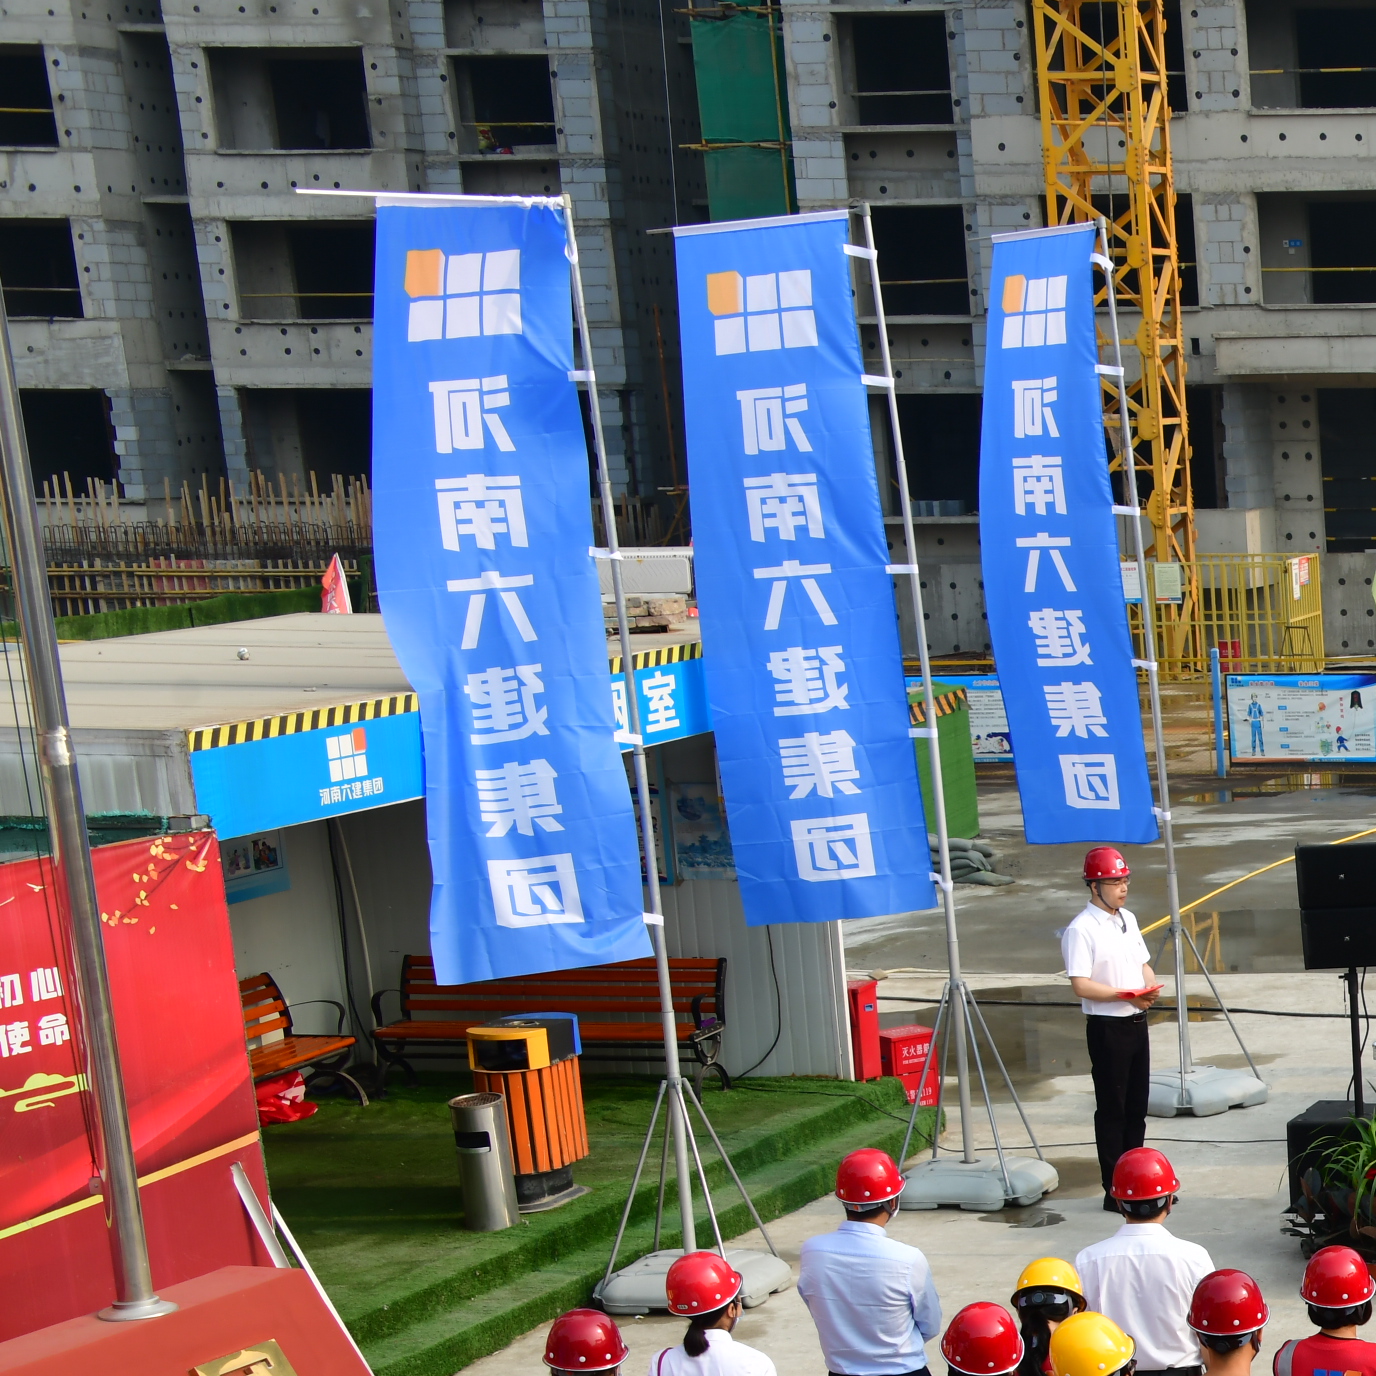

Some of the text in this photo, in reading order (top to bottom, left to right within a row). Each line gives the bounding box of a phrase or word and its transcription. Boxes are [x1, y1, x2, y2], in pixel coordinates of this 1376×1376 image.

[319, 776, 385, 808] 河南六建集团
